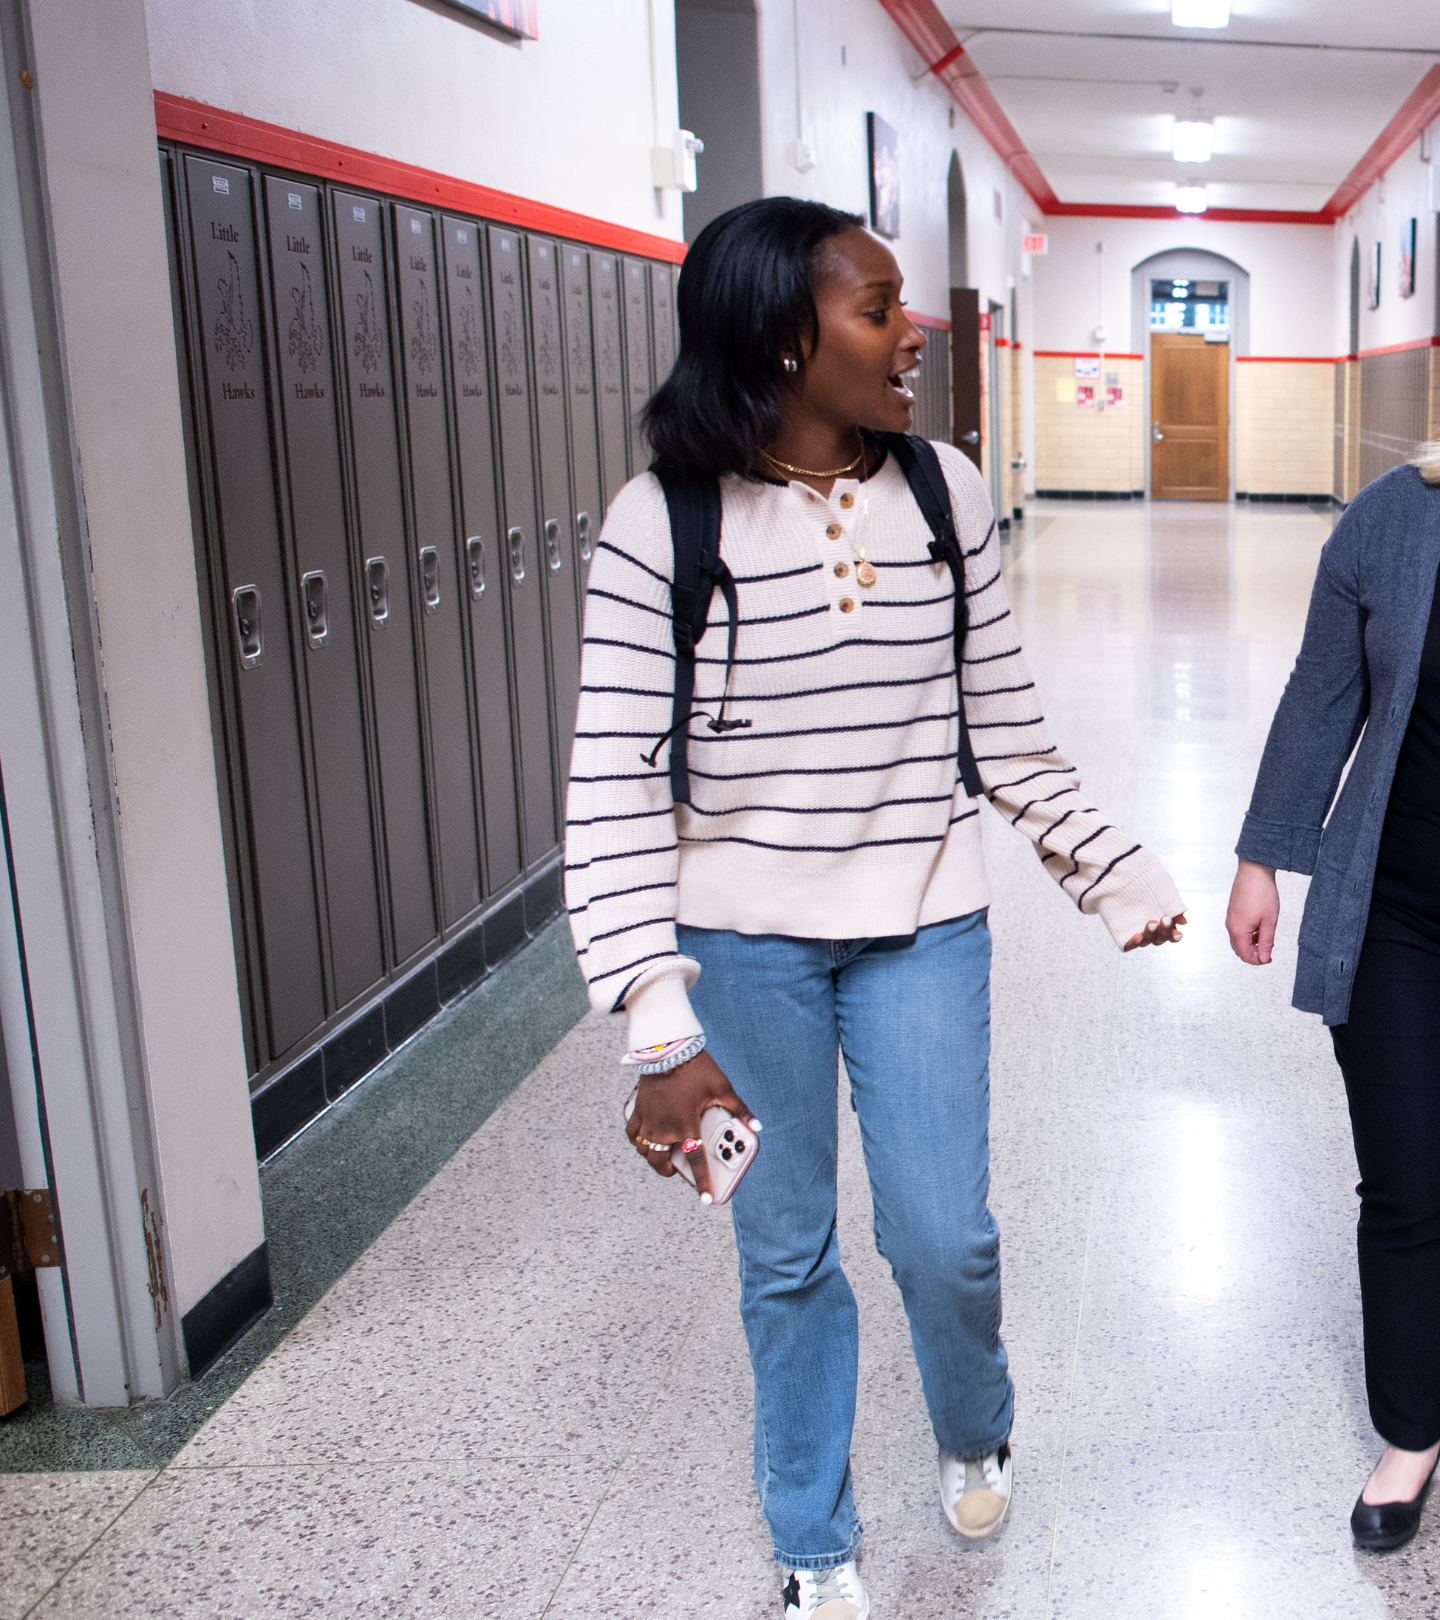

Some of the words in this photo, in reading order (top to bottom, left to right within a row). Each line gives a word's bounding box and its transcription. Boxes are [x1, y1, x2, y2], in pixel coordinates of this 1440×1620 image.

[211, 222, 239, 242] Little
[286, 235, 310, 254] Little
[352, 246, 372, 263] Little
[222, 382, 255, 399] Hawks
[295, 382, 325, 399] Hawks
[359, 383, 385, 398] Hawks
